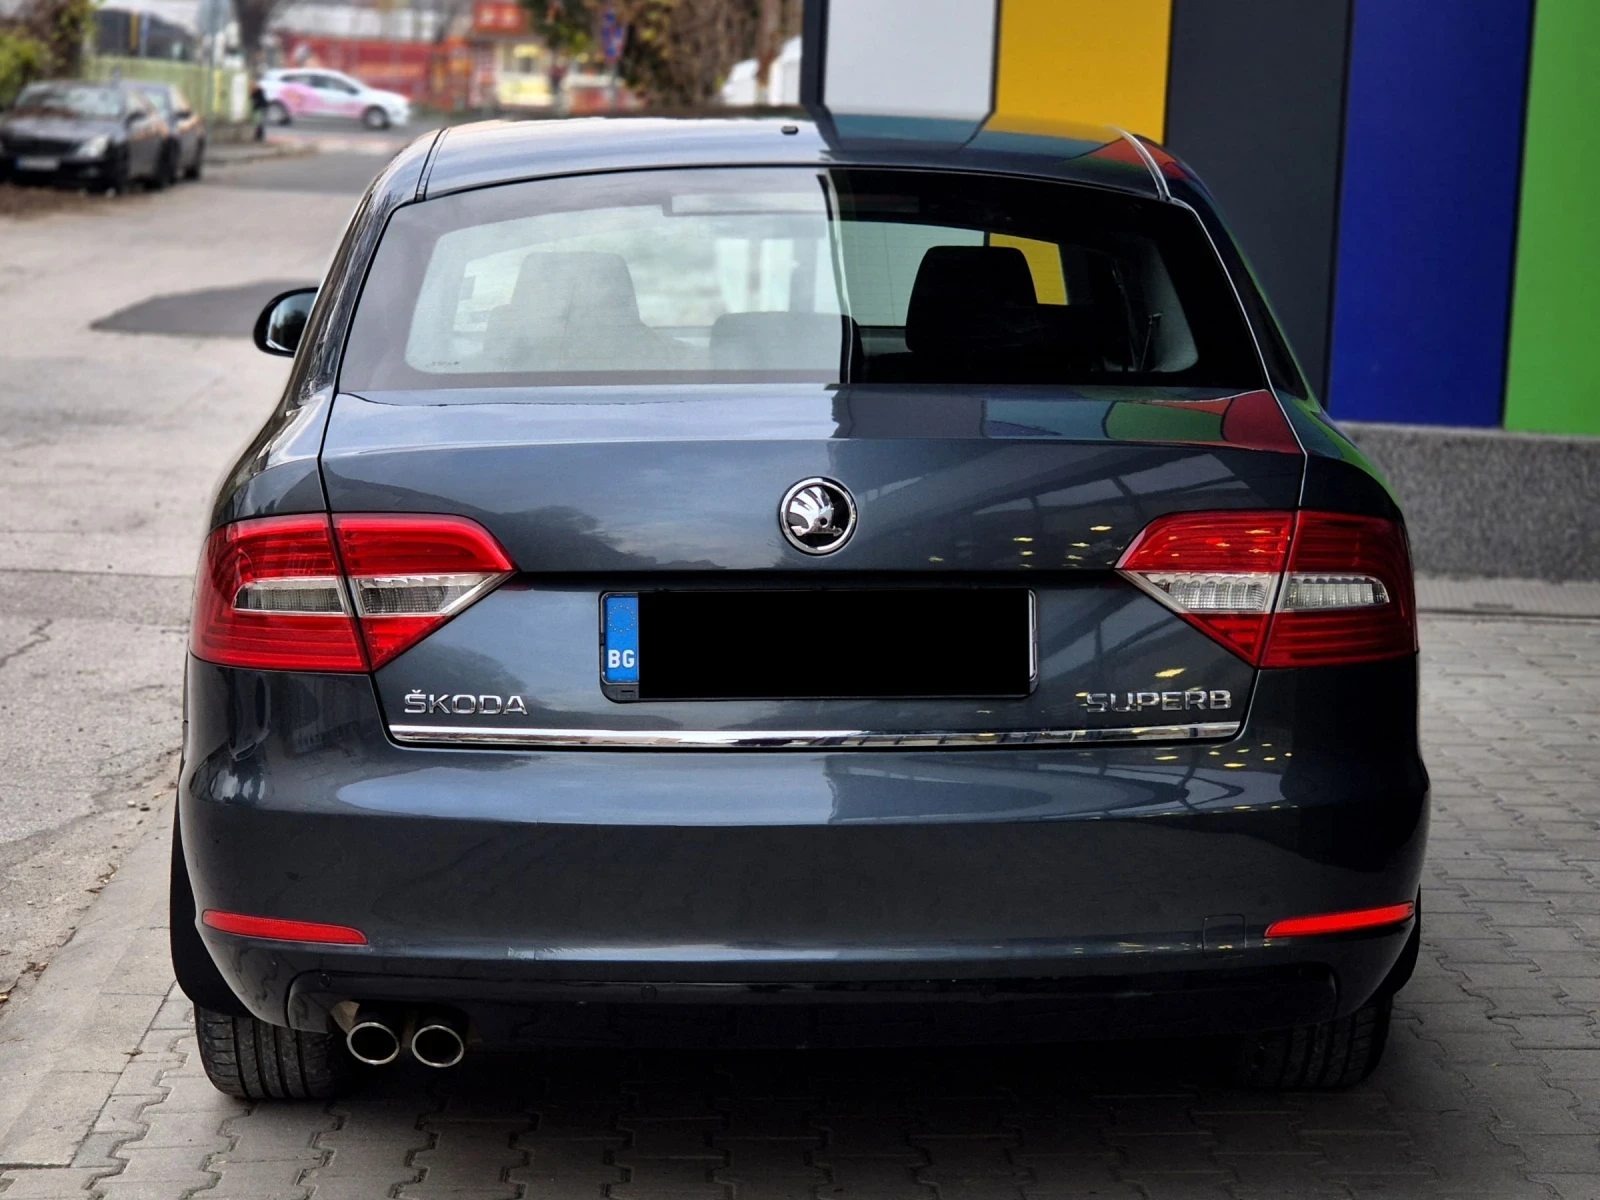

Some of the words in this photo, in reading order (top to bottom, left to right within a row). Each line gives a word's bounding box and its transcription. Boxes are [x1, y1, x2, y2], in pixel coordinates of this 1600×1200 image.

[607, 649, 635, 668] BG
[404, 689, 529, 715] ŠKODA
[1086, 689, 1232, 713] SUPERB
